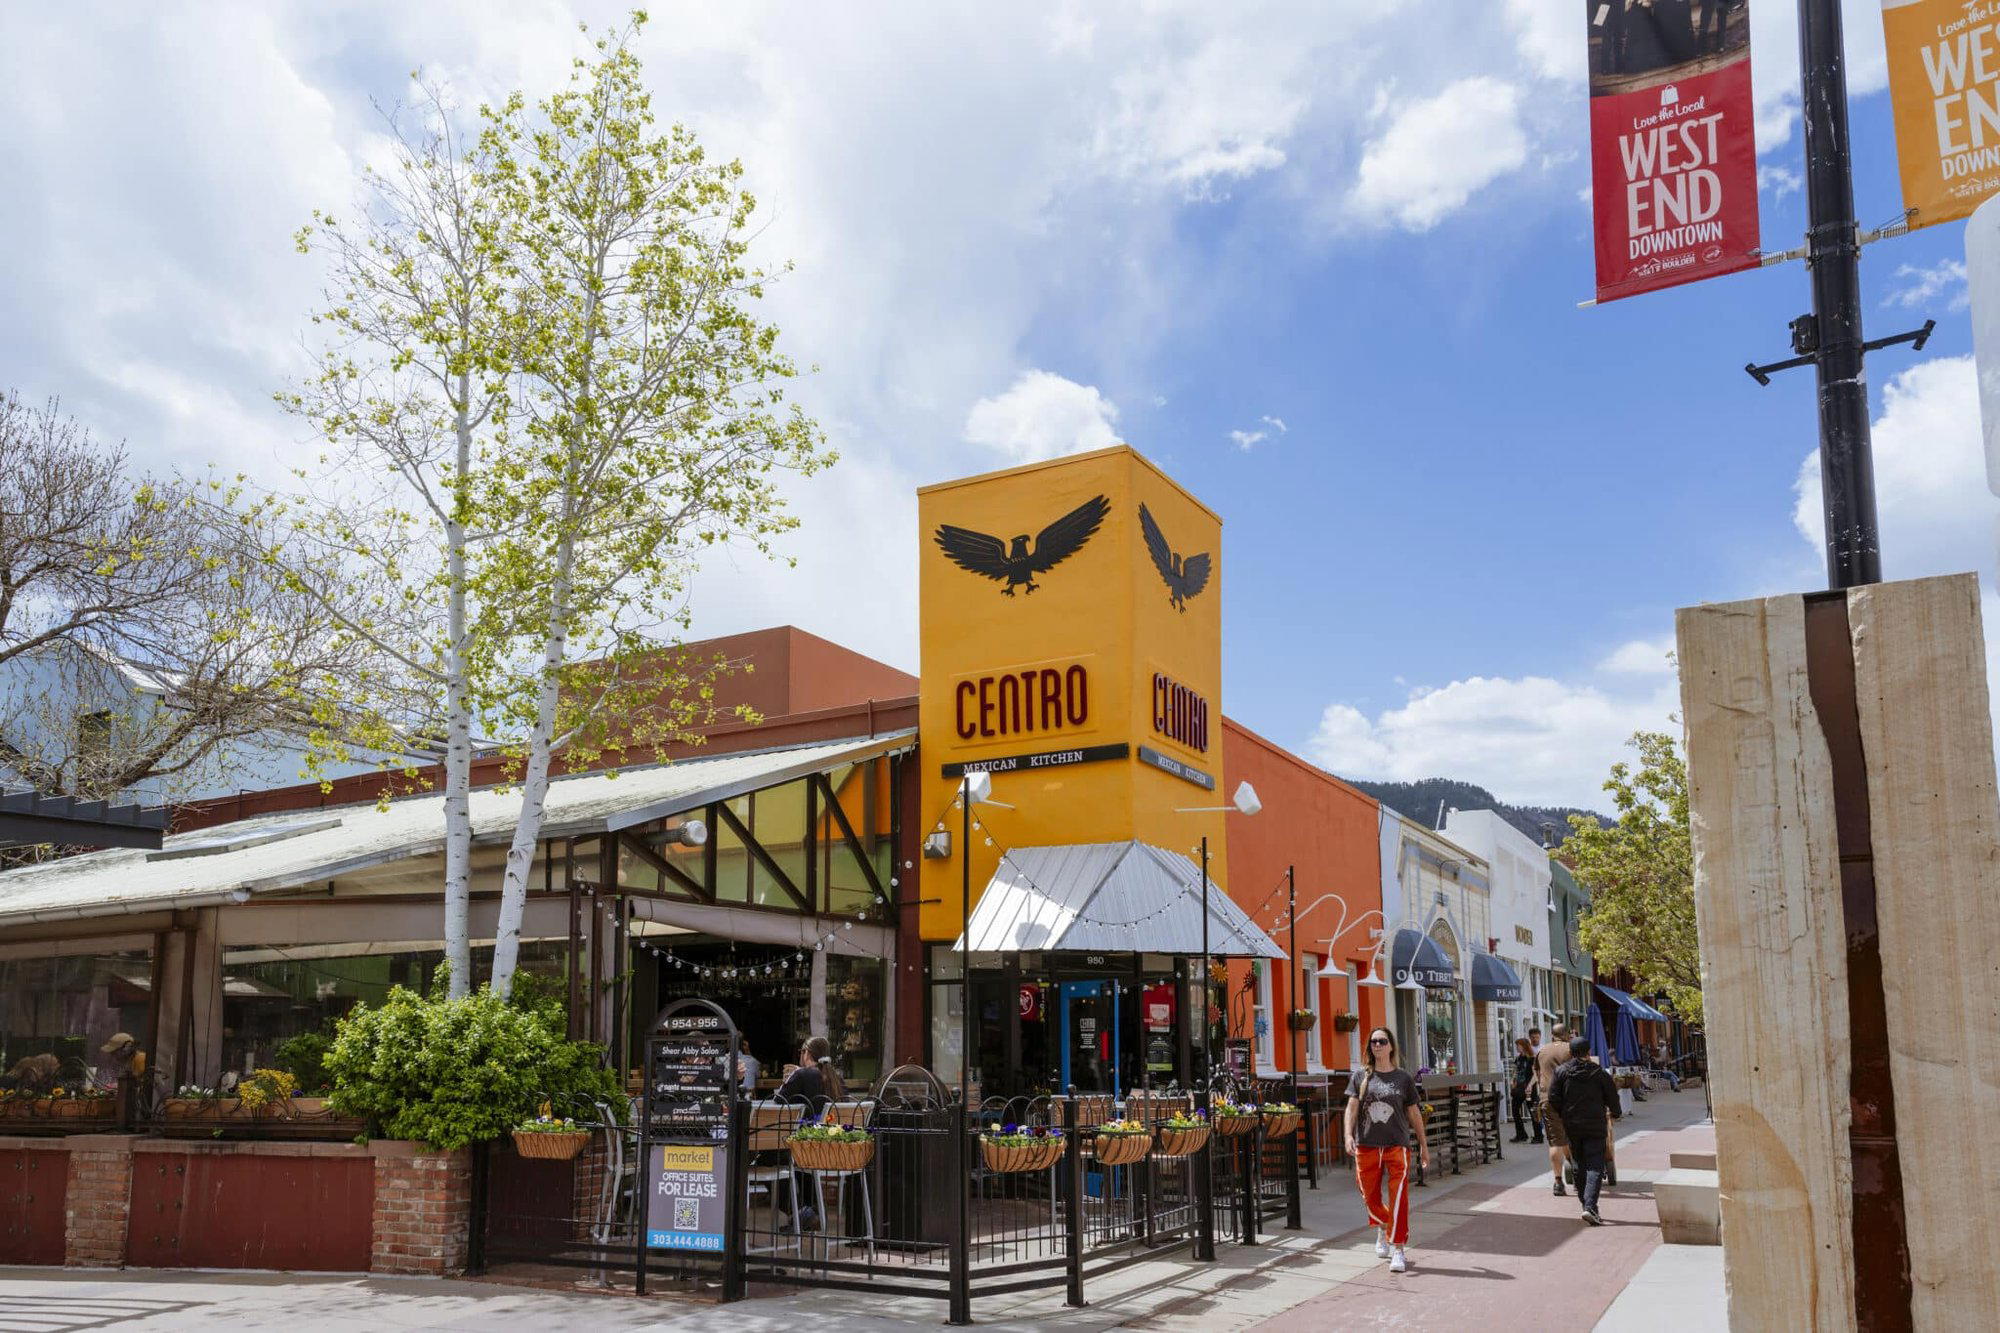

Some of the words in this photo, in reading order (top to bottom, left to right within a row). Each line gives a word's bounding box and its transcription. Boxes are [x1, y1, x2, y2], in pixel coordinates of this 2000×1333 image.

[1938, 18, 1967, 37] Love
[1968, 6, 1986, 24] the
[1921, 22, 2000, 96] WE
[1633, 117, 1659, 130] Love
[1659, 106, 1674, 120] the
[1675, 95, 1705, 116] Local
[1619, 112, 1724, 182] WEST
[1627, 169, 1722, 238] END
[1629, 221, 1723, 260] DOWNTOWN
[955, 664, 1089, 740] CENTRO
[1153, 672, 1208, 753] CENTRO
[963, 758, 1017, 775] MEXICAN
[1030, 751, 1083, 767] KITCHEN
[1396, 969, 1424, 981] OD
[662, 1046, 680, 1055] Shear
[682, 1046, 700, 1057] Abby
[700, 1045, 720, 1055] Salon
[667, 1151, 710, 1164] market
[658, 1182, 681, 1196] FOR
[683, 1183, 718, 1198] LEASE
[662, 1172, 688, 1182] OFFICE
[689, 1173, 714, 1183] SUITES
